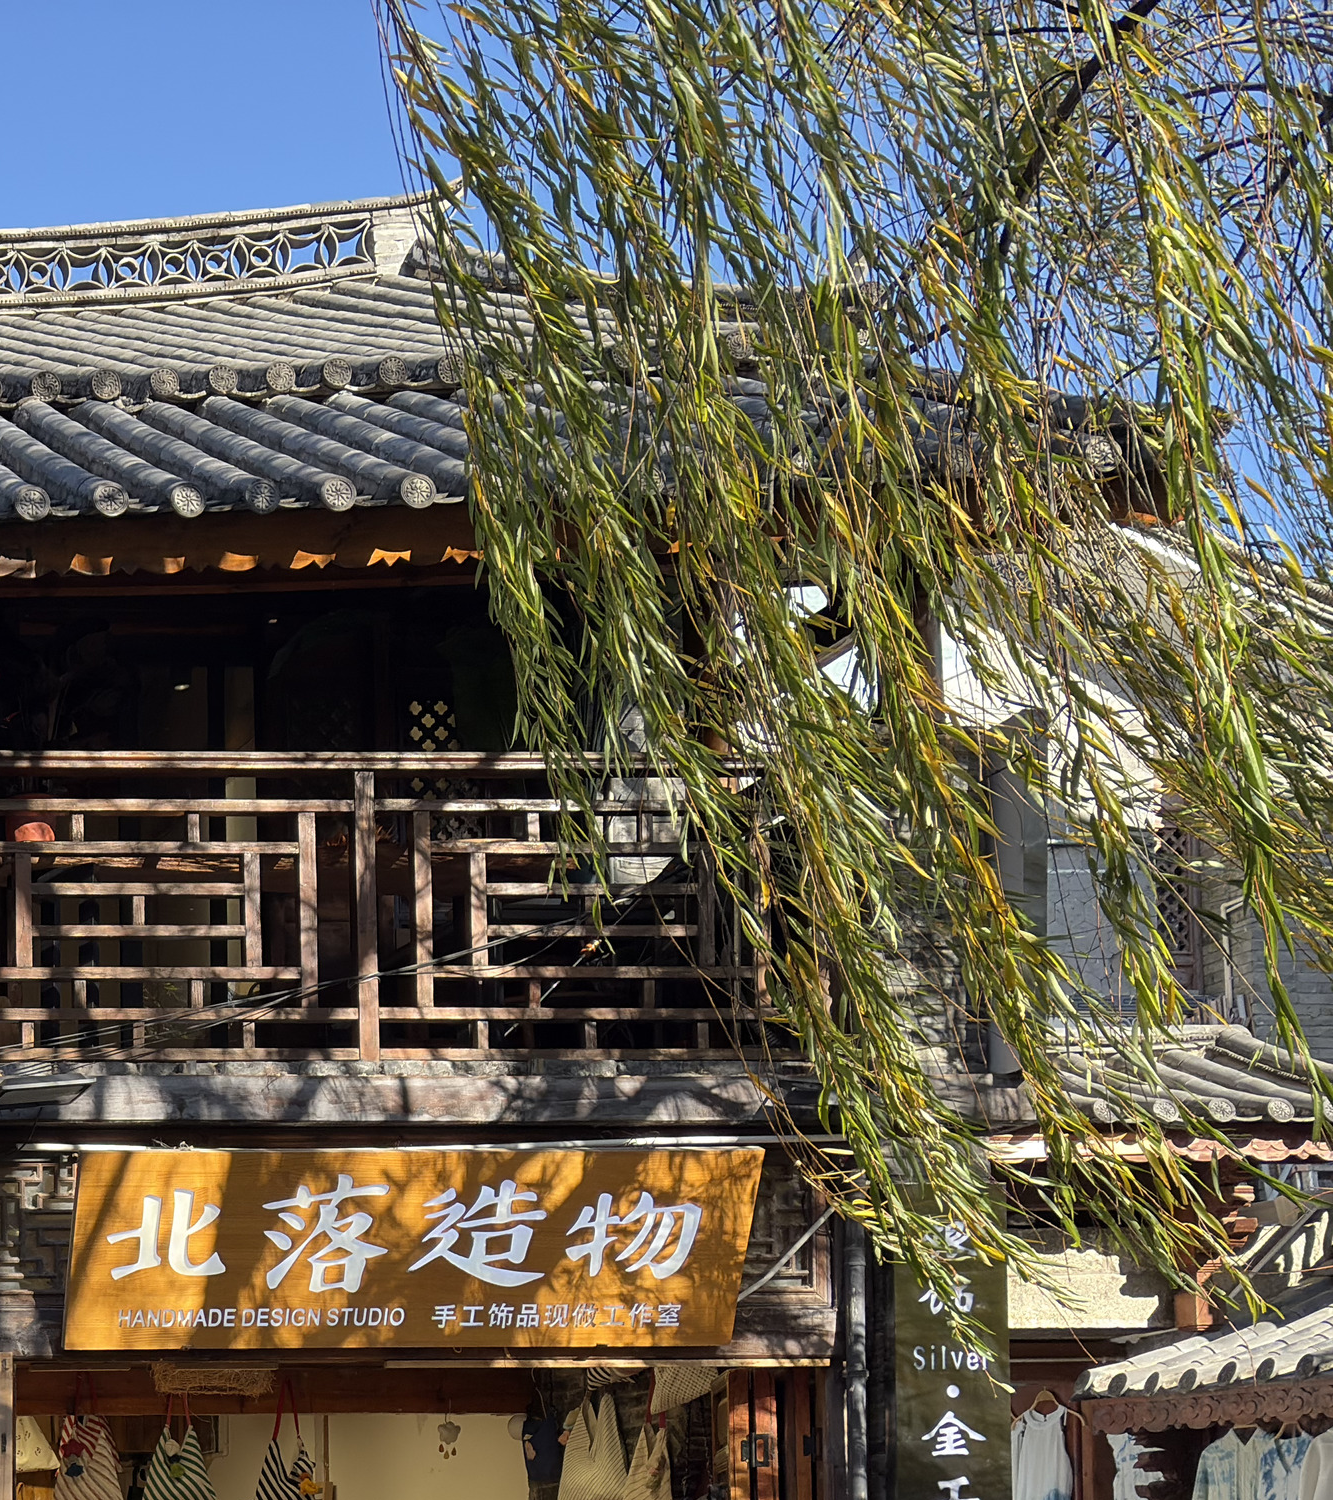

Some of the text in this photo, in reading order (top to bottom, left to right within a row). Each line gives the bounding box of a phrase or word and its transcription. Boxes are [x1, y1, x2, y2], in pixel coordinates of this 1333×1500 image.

[106, 1174, 703, 1293] 北落造物
[118, 1306, 406, 1328] HANDMADE DESIGN STUDIO
[431, 1302, 683, 1329] 手工饰品现做工作室
